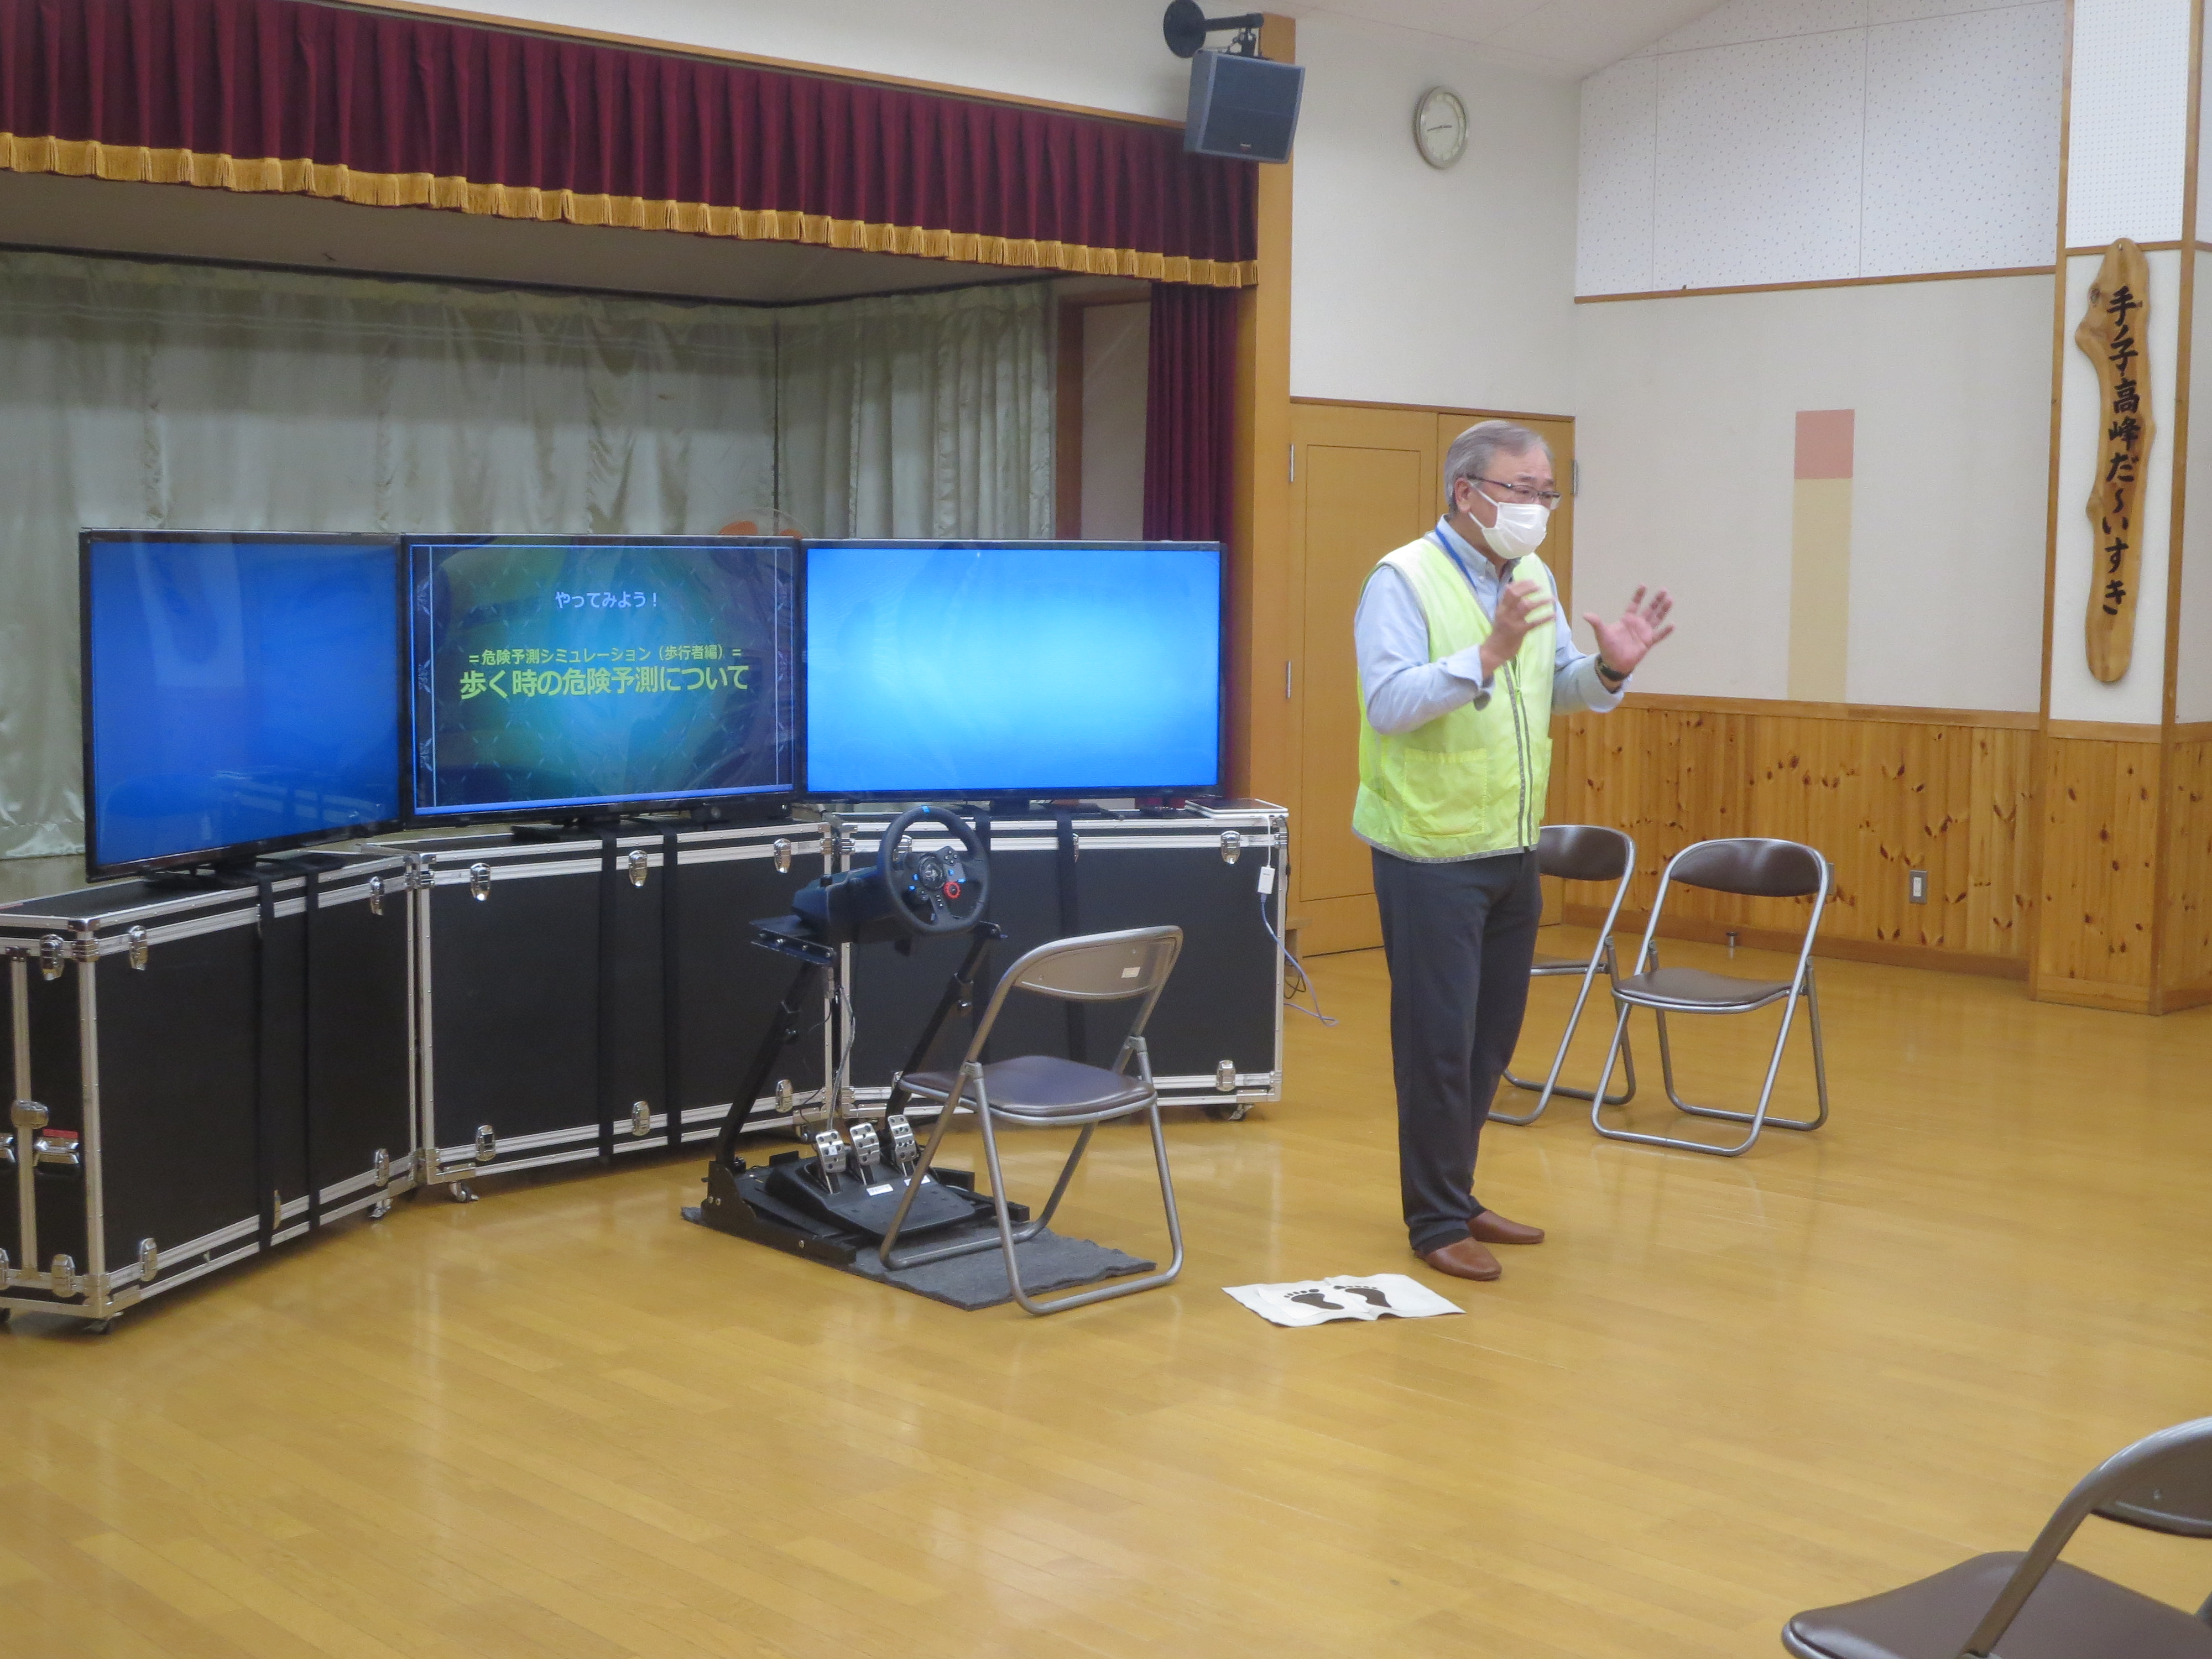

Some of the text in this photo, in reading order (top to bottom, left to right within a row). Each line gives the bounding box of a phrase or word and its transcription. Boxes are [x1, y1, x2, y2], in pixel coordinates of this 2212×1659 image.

[460, 665, 749, 700] 歩く時の危険予測について
